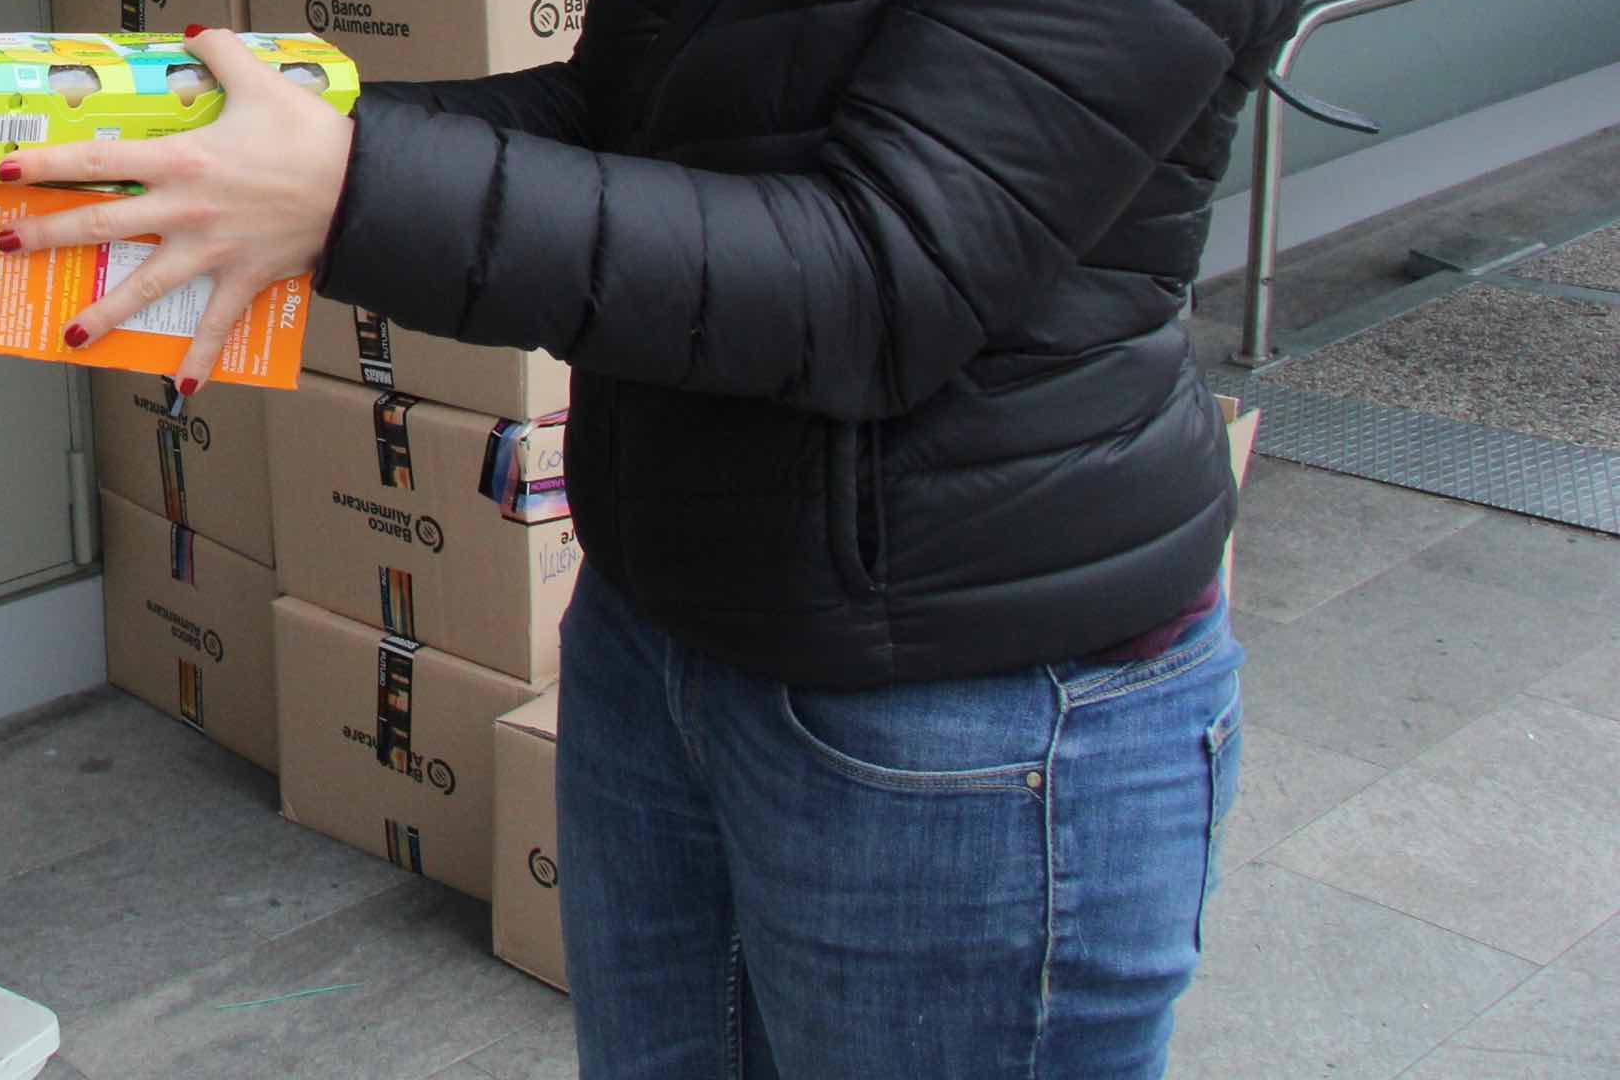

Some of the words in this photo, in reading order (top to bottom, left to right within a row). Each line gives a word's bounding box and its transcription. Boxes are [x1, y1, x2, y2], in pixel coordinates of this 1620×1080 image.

[332, 18, 411, 38] Alimentare
[280, 294, 302, 330] 720g
[332, 491, 413, 527] Alimentare
[368, 516, 413, 544] Banco
